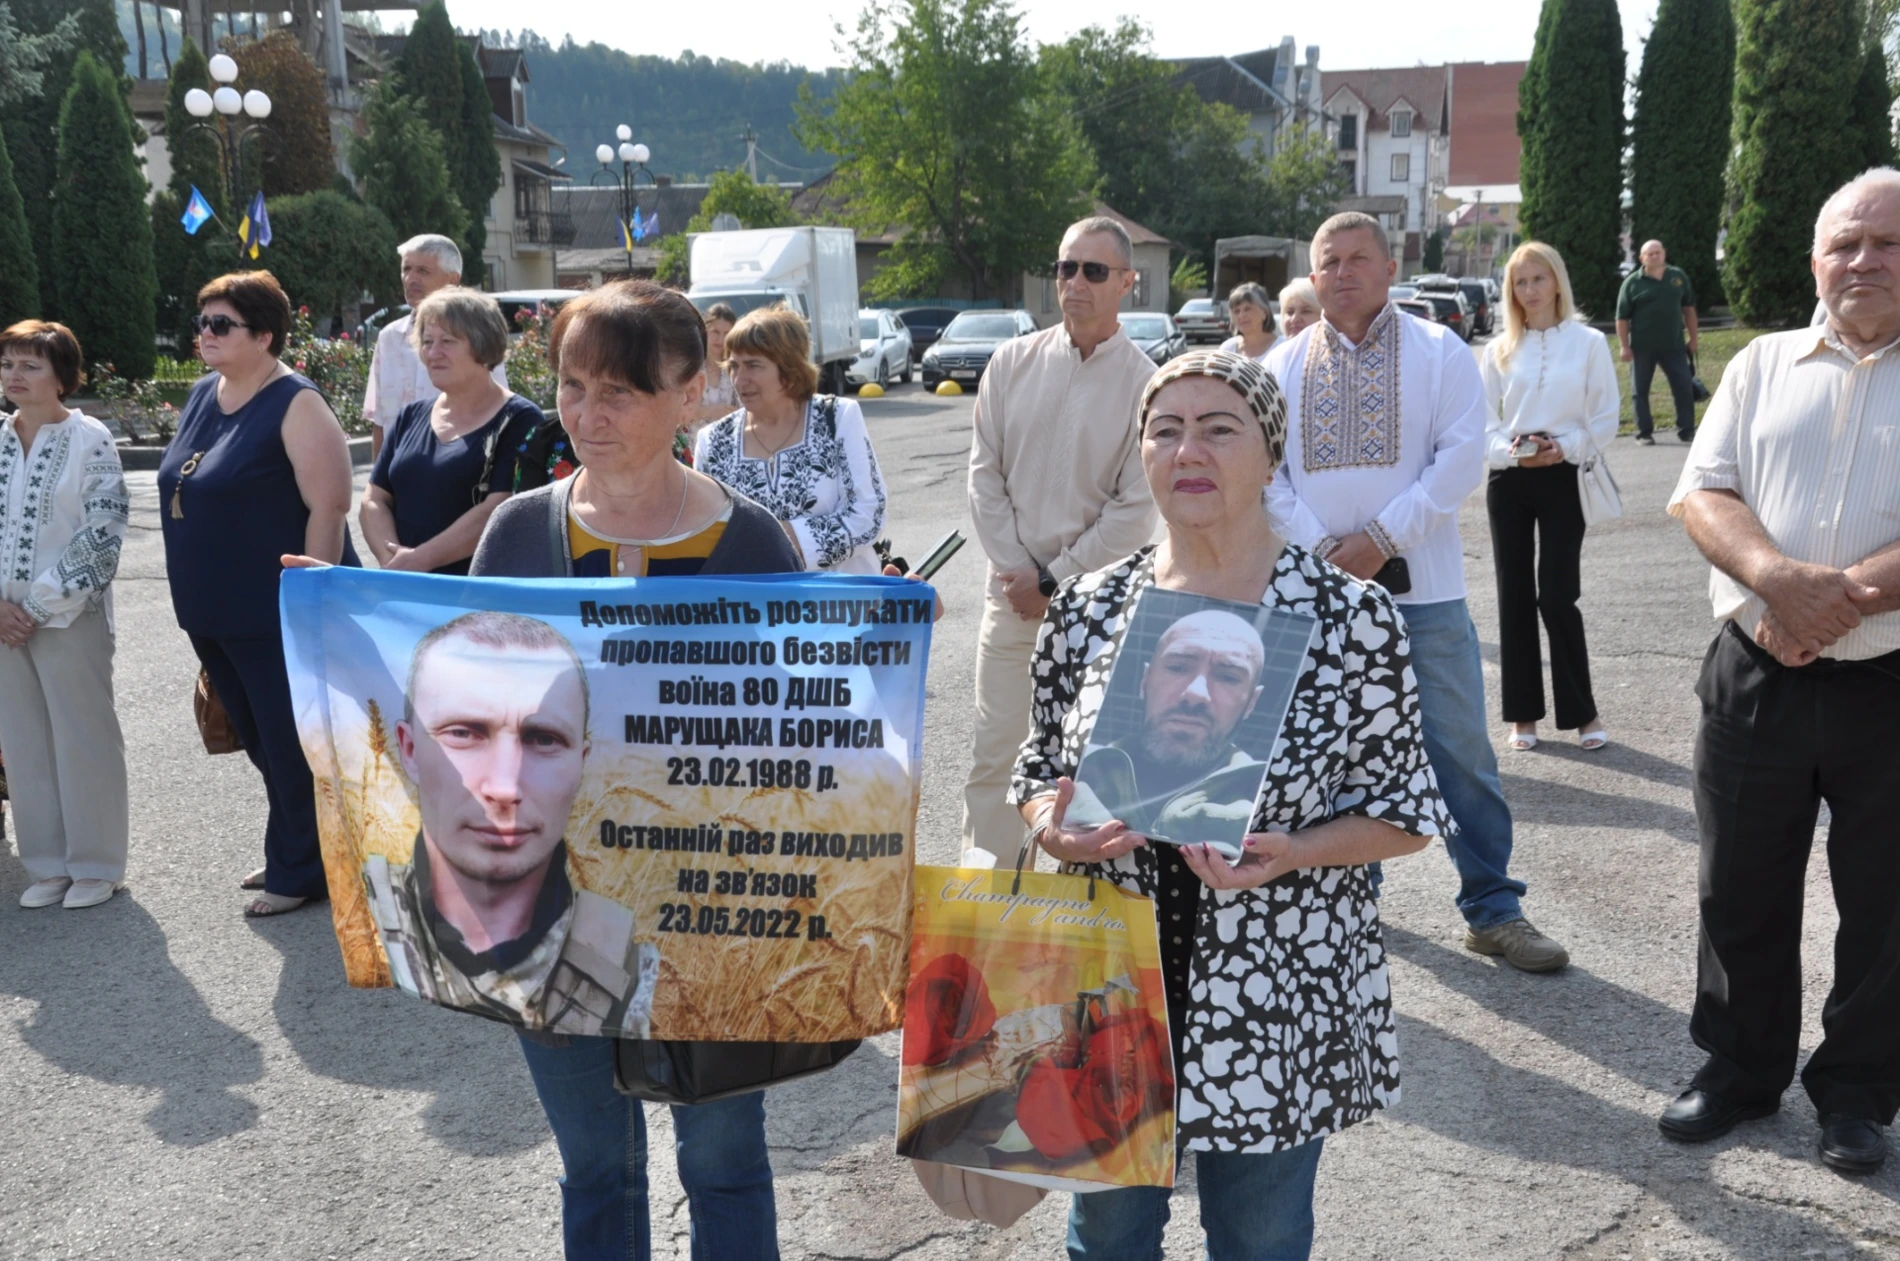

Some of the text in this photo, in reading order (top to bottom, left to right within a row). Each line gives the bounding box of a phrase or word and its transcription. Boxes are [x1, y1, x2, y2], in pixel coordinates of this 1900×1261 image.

[580, 597, 931, 628] Допоможіть розшукати
[600, 636, 912, 667] пропавшого безвісти
[659, 675, 852, 711] воїна 80 ДШБ
[624, 715, 884, 750] МАРУЩАКА БОРИСА
[667, 757, 838, 792] 23.02.1988 р.
[600, 819, 904, 862] Останній раз виходив
[678, 867, 817, 898] на зв'язок
[940, 874, 1092, 926] Champagne
[658, 903, 832, 941] 23.05.2022 р.
